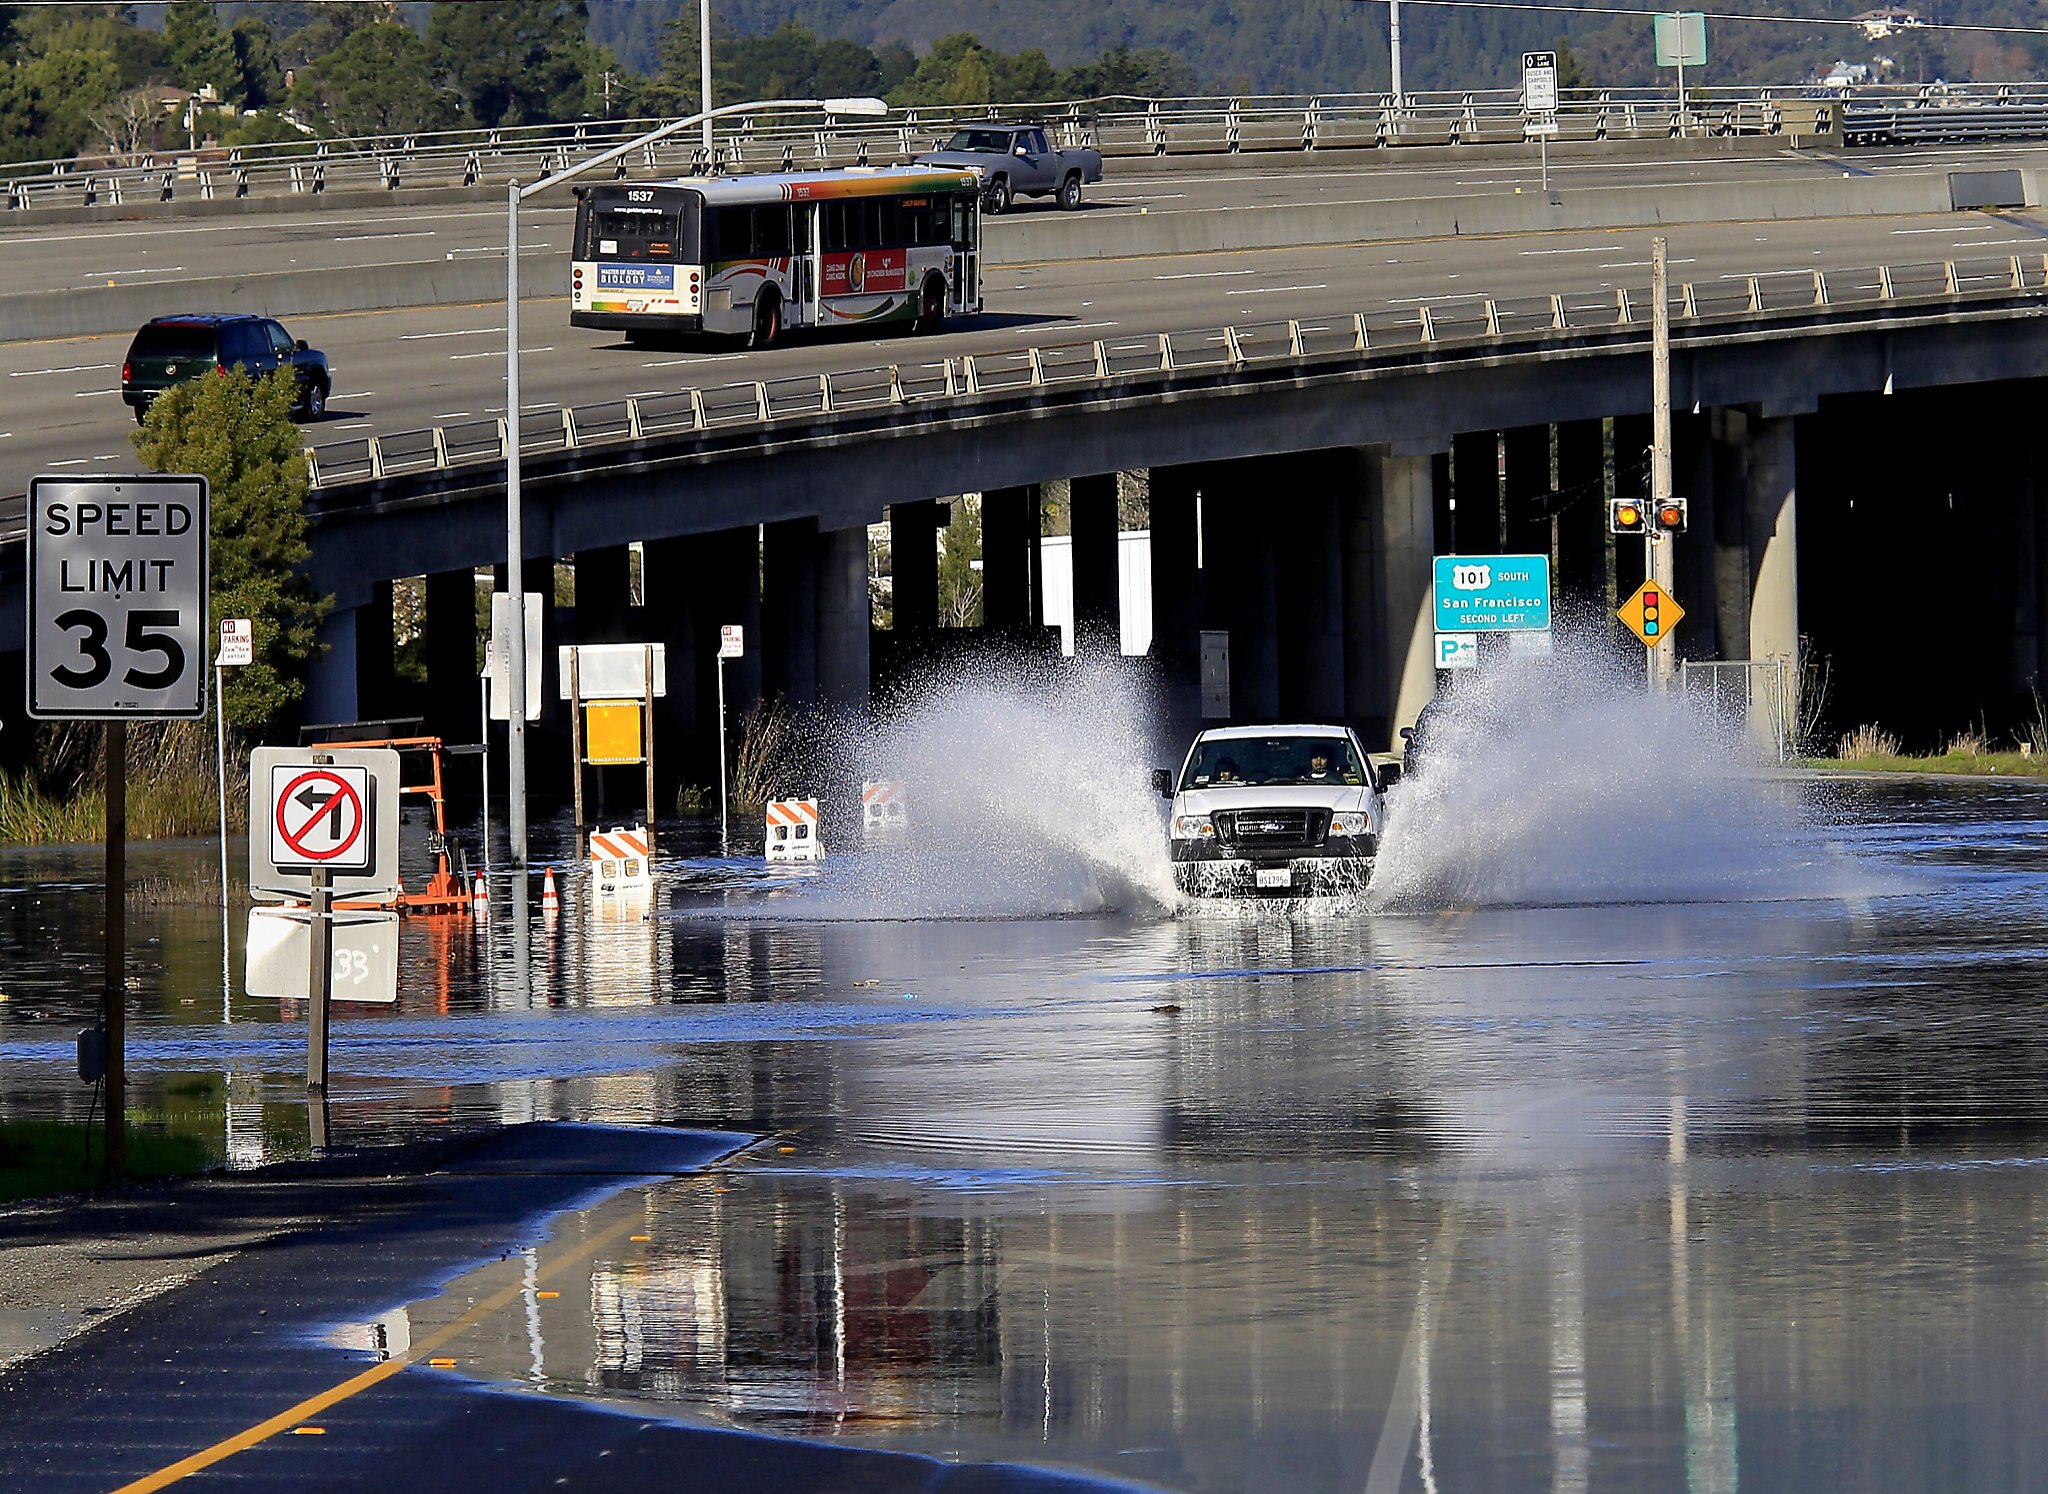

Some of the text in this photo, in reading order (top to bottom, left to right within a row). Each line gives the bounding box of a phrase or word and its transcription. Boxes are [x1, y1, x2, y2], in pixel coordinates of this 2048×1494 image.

[959, 176, 973, 186] 1537
[627, 190, 654, 202] 1537
[796, 187, 810, 197] 1537
[601, 275, 645, 284] BIOLOGY
[45, 503, 192, 536] SPEED
[60, 560, 175, 592] LIMIT
[1461, 572, 1529, 584] 101 SOUTH
[1443, 596, 1541, 608] San Francisco
[1460, 613, 1525, 623] SECOND LEFT
[224, 622, 234, 632] NO
[224, 635, 250, 643] PARKING
[50, 609, 186, 690] 35
